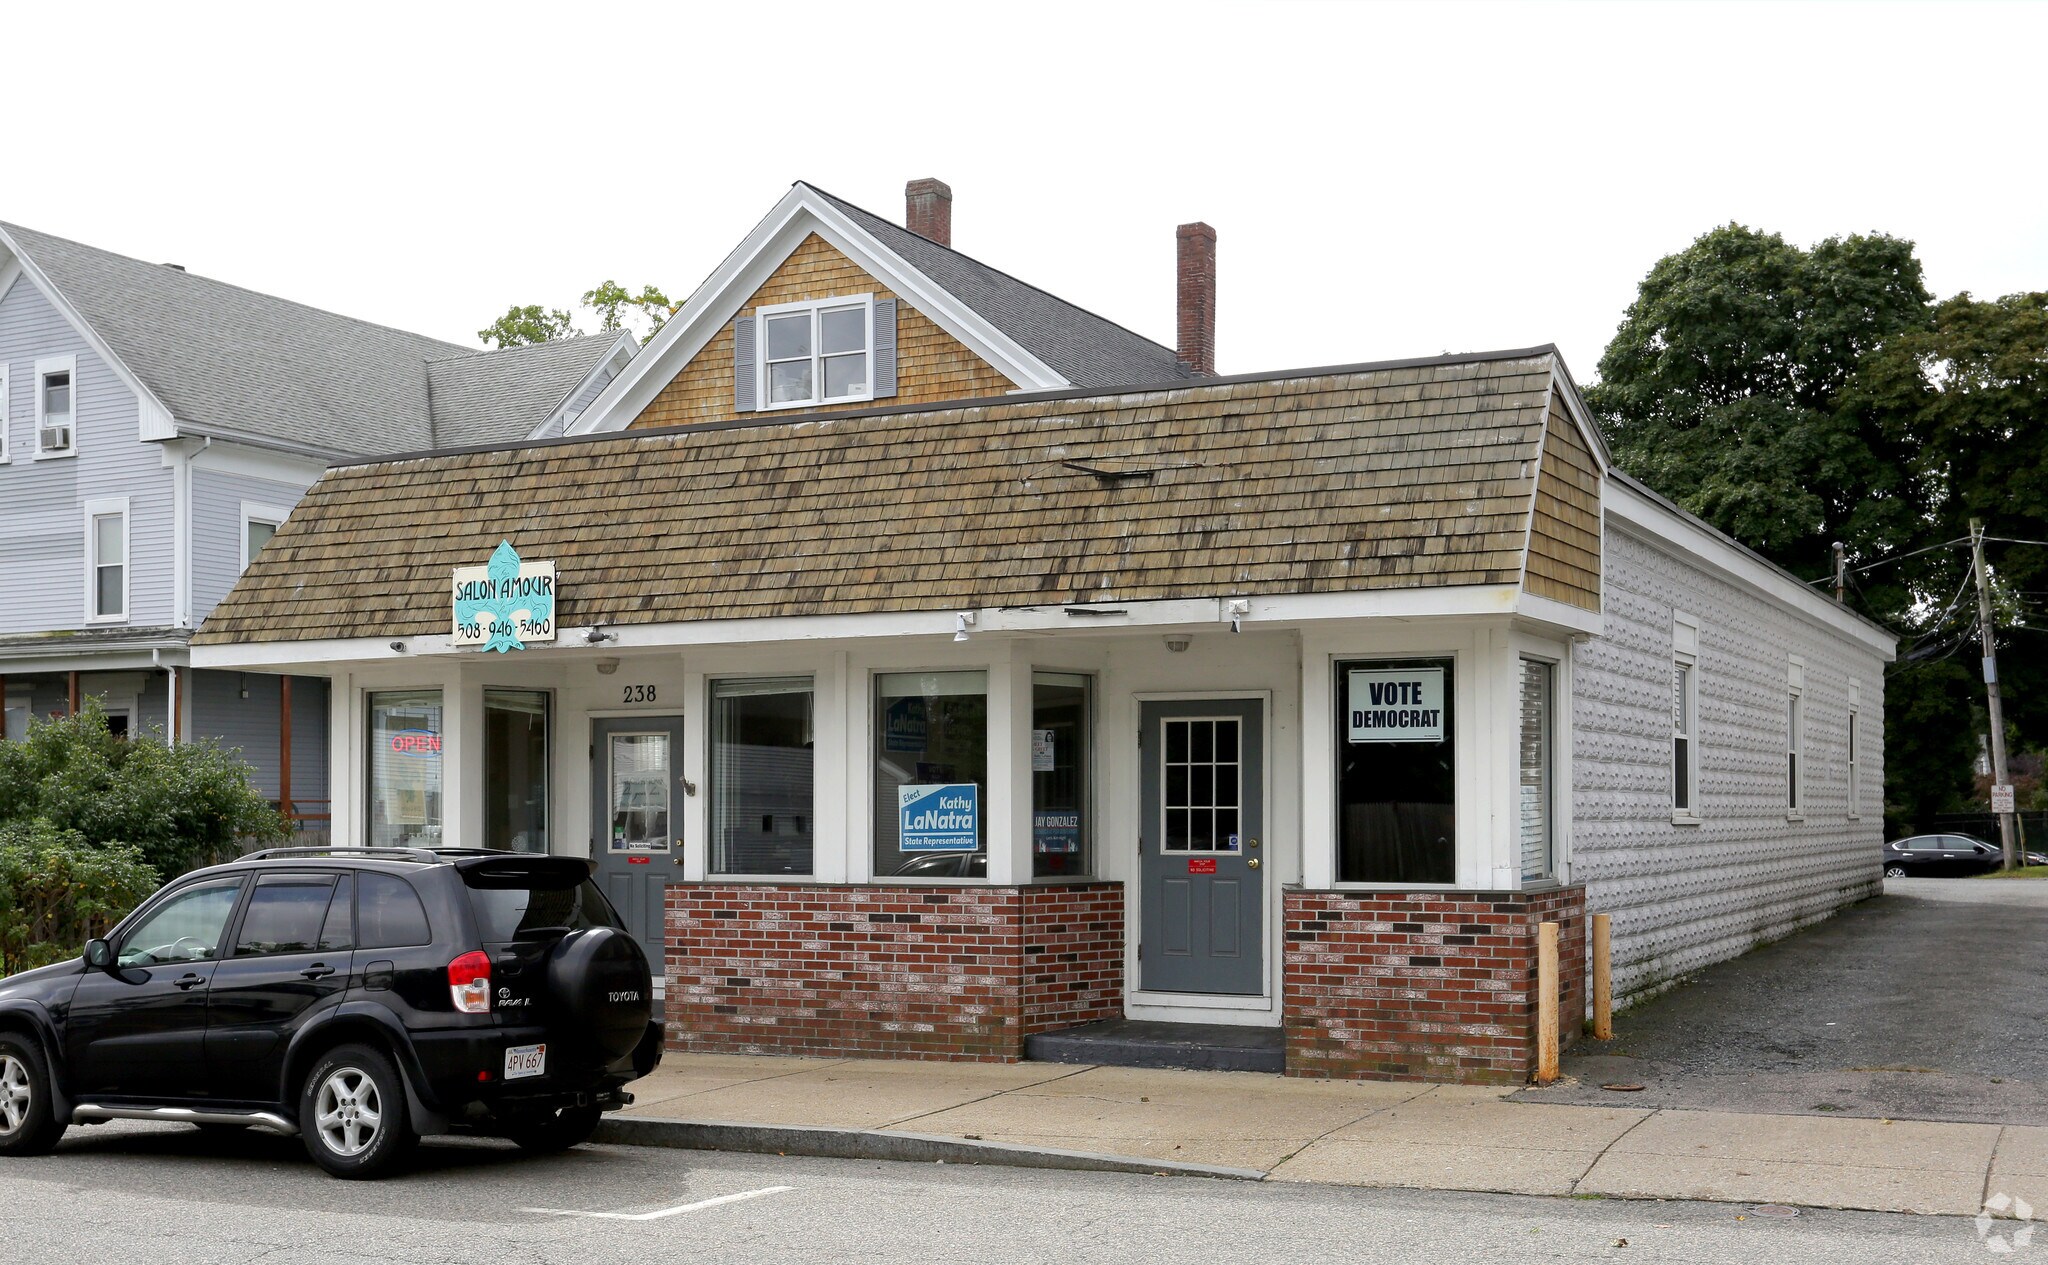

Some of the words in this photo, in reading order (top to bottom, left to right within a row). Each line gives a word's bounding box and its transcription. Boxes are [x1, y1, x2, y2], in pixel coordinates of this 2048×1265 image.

[455, 579, 497, 601] SALON
[500, 575, 553, 598] AMOUR
[623, 685, 656, 703] 238
[1369, 681, 1422, 705] VOTE
[888, 713, 926, 733] LaNatra
[1353, 710, 1440, 728] DEMOCRAT
[391, 736, 442, 753] OPEN
[903, 789, 921, 803] Elect
[939, 796, 972, 812] Kathy
[904, 810, 973, 830] LaNatra
[1034, 816, 1046, 827] JAY
[1046, 816, 1078, 827] GONZALEZ
[904, 837, 923, 845] State
[923, 837, 974, 847] Representative
[608, 991, 640, 1002] TOYOTA
[507, 1054, 524, 1071] 4PV
[526, 1052, 544, 1068] 667
